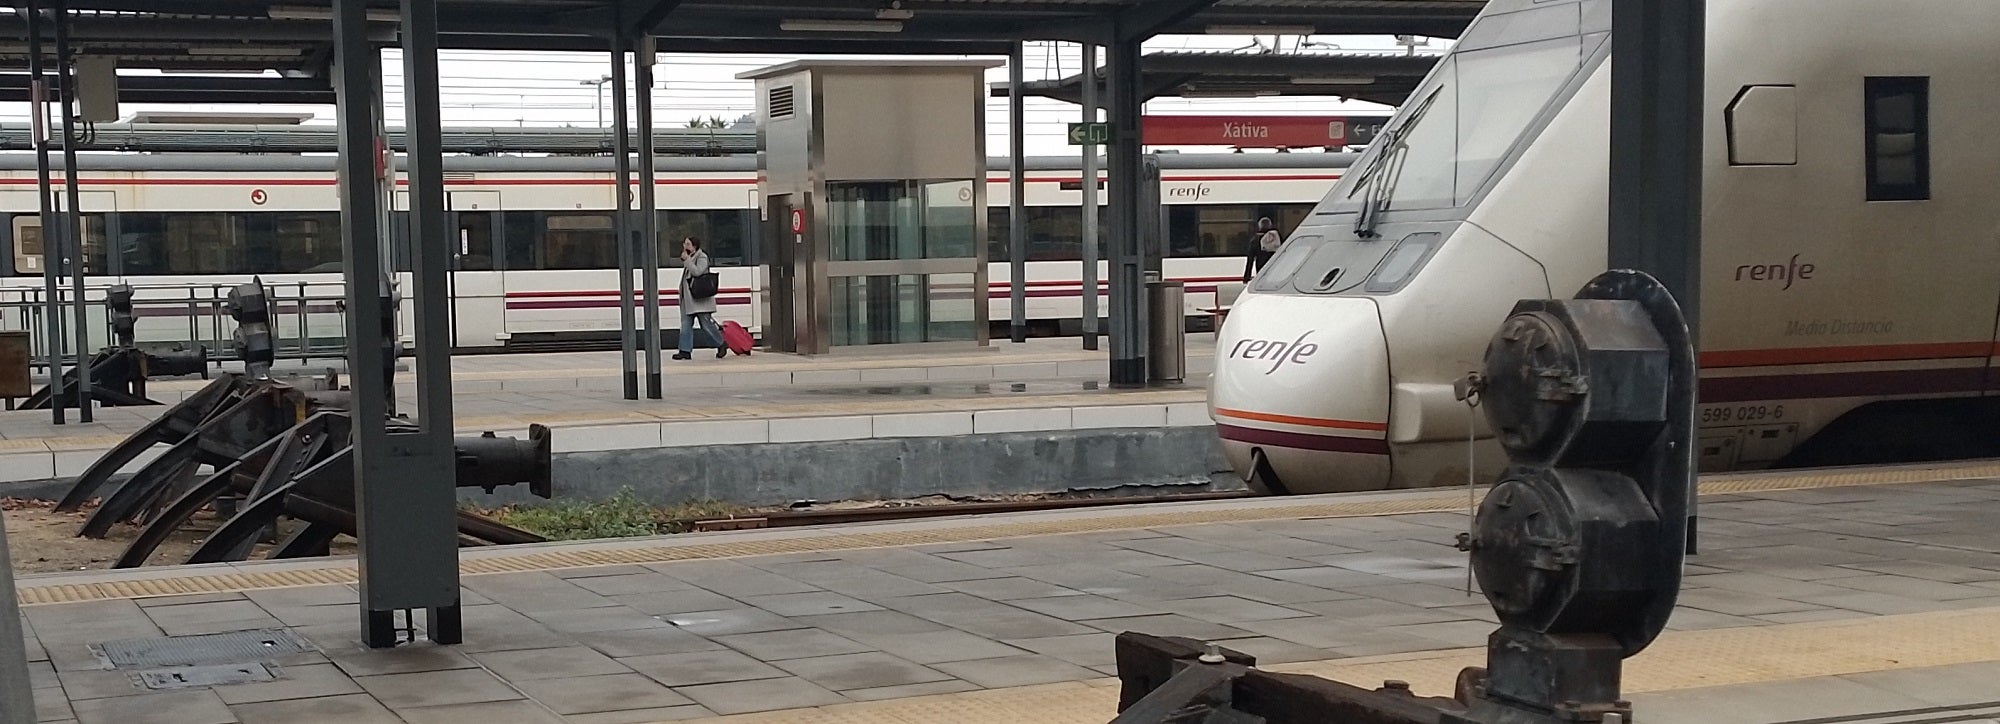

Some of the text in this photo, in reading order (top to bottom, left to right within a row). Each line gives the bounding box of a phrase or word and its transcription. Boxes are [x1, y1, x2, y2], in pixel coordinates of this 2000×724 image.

[1223, 121, 1268, 138] Xàtiva
[1170, 182, 1211, 201] renfe
[1735, 253, 1815, 291] renfe
[1785, 318, 1893, 336] Media Distancia
[1229, 329, 1318, 375] renfe
[1703, 405, 1784, 422] 599 029-6
